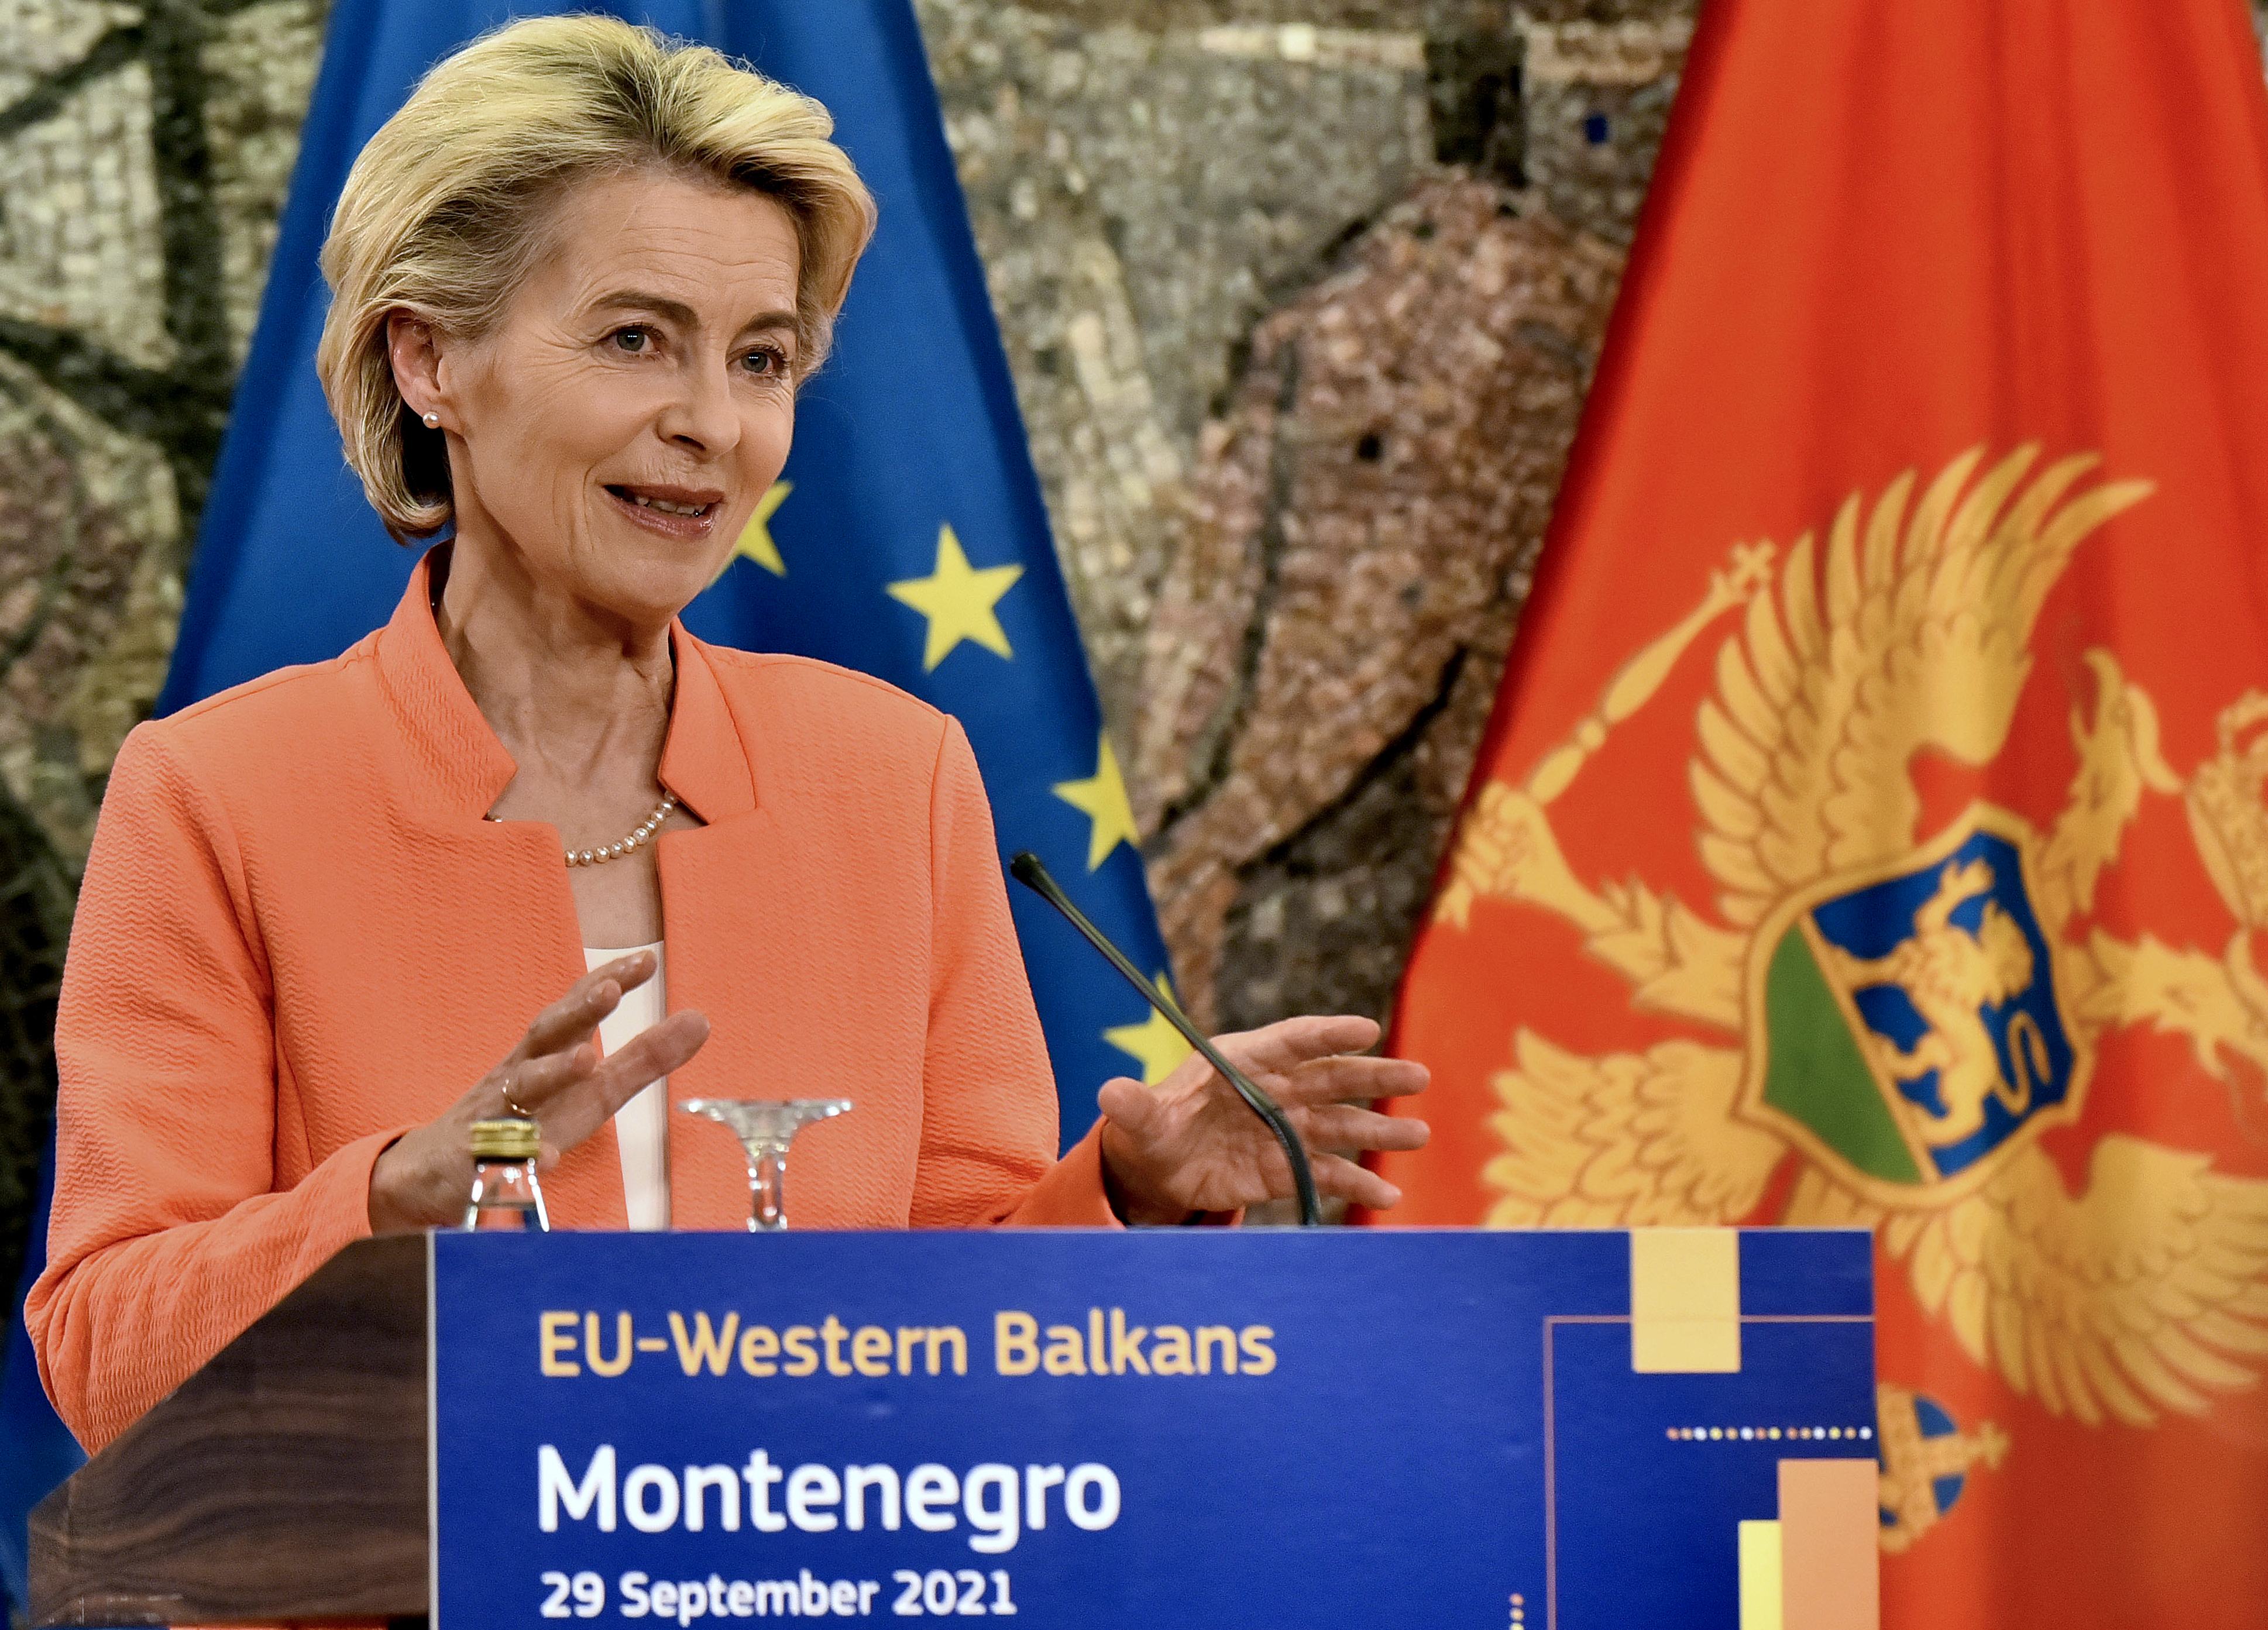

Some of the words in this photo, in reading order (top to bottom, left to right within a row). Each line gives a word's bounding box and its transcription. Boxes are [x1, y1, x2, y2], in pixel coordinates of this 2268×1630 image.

[539, 1311, 968, 1377] EU-Western
[994, 1306, 1277, 1377] Balkans
[538, 1445, 1121, 1553] Montenegro
[541, 1572, 605, 1618] 29
[620, 1569, 880, 1627] September
[893, 1570, 1017, 1616] 2021
